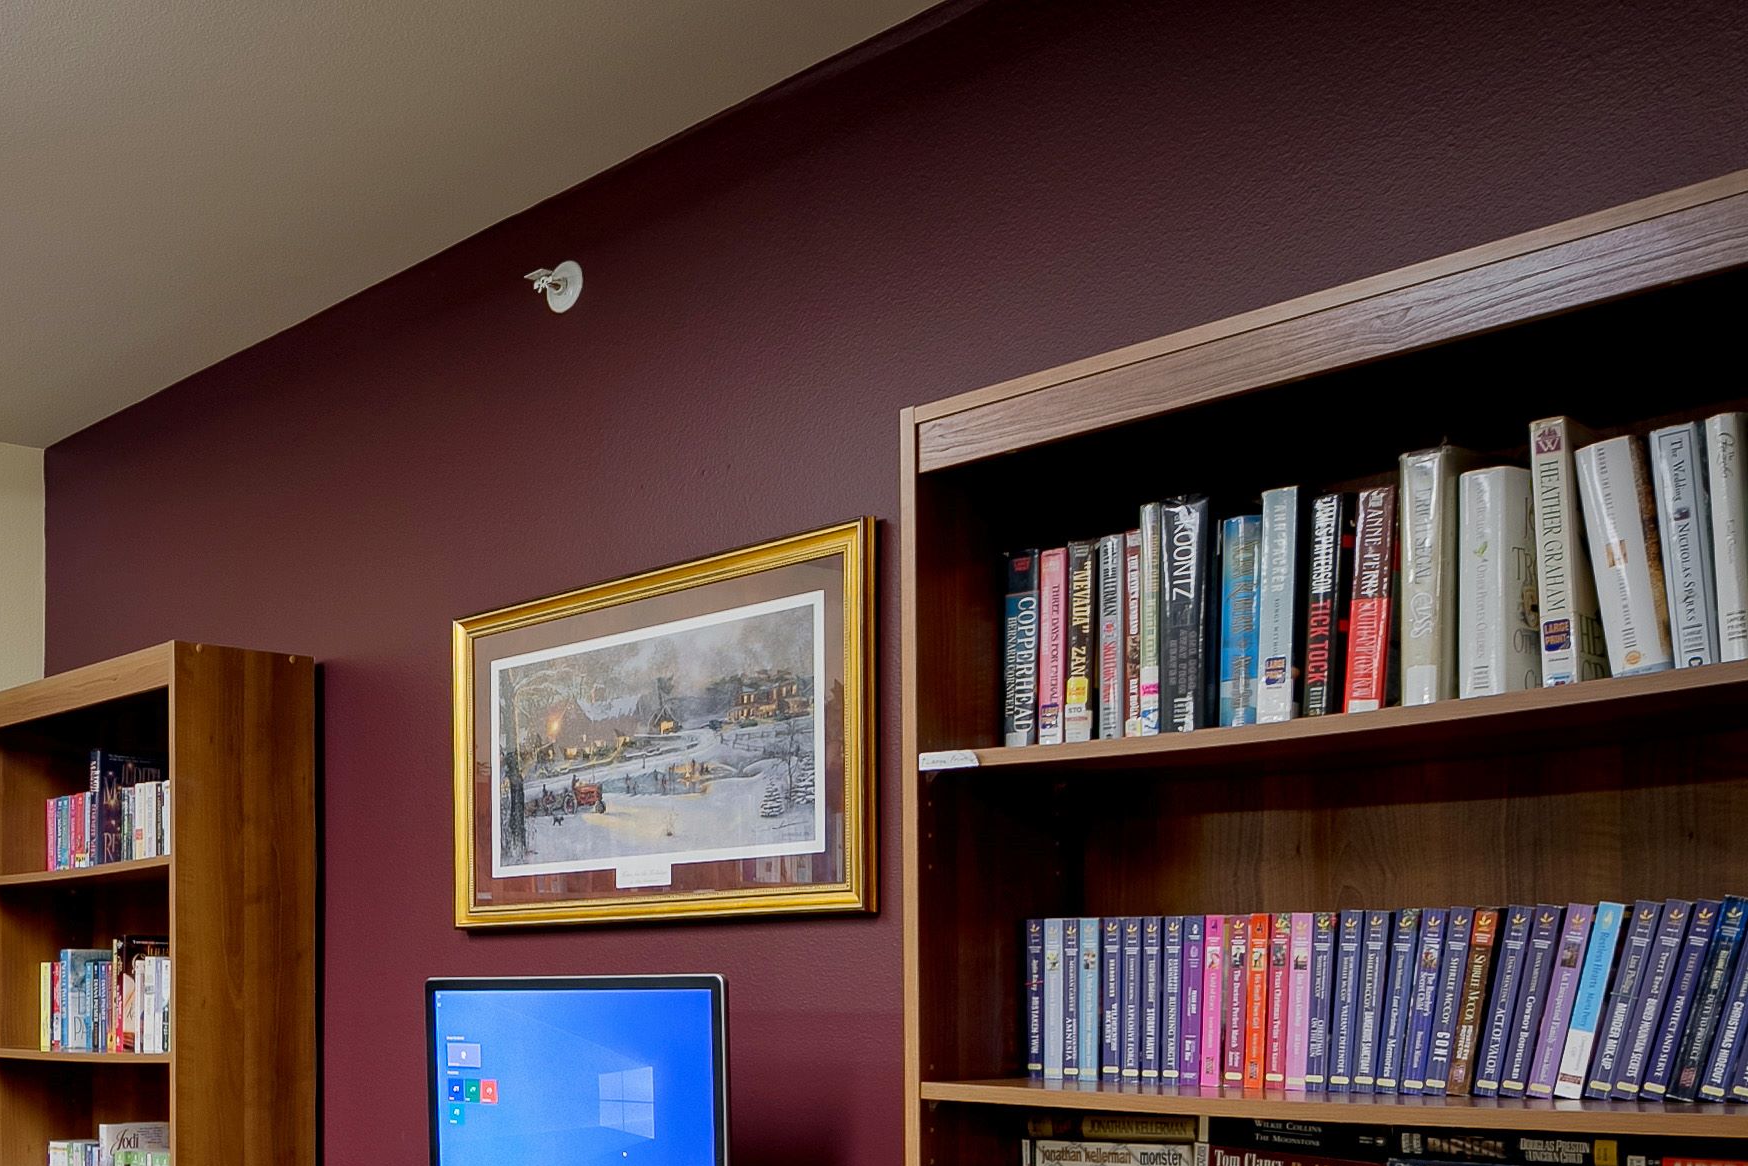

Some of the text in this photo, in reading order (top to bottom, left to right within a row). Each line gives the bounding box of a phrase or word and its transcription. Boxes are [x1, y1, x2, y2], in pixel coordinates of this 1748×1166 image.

[1172, 520, 1194, 601] KOONTZ
[1539, 460, 1566, 614] HEATHER GRAHAM
[1012, 596, 1038, 732] COPPERHEAD
[1601, 1002, 1628, 1070] MURDER MIX-UP
[1710, 1001, 1745, 1084] CHRISTMAS HIDEOUT
[114, 1130, 140, 1155] Jodi
[1041, 1146, 1183, 1166] jonathan kellerman monster
